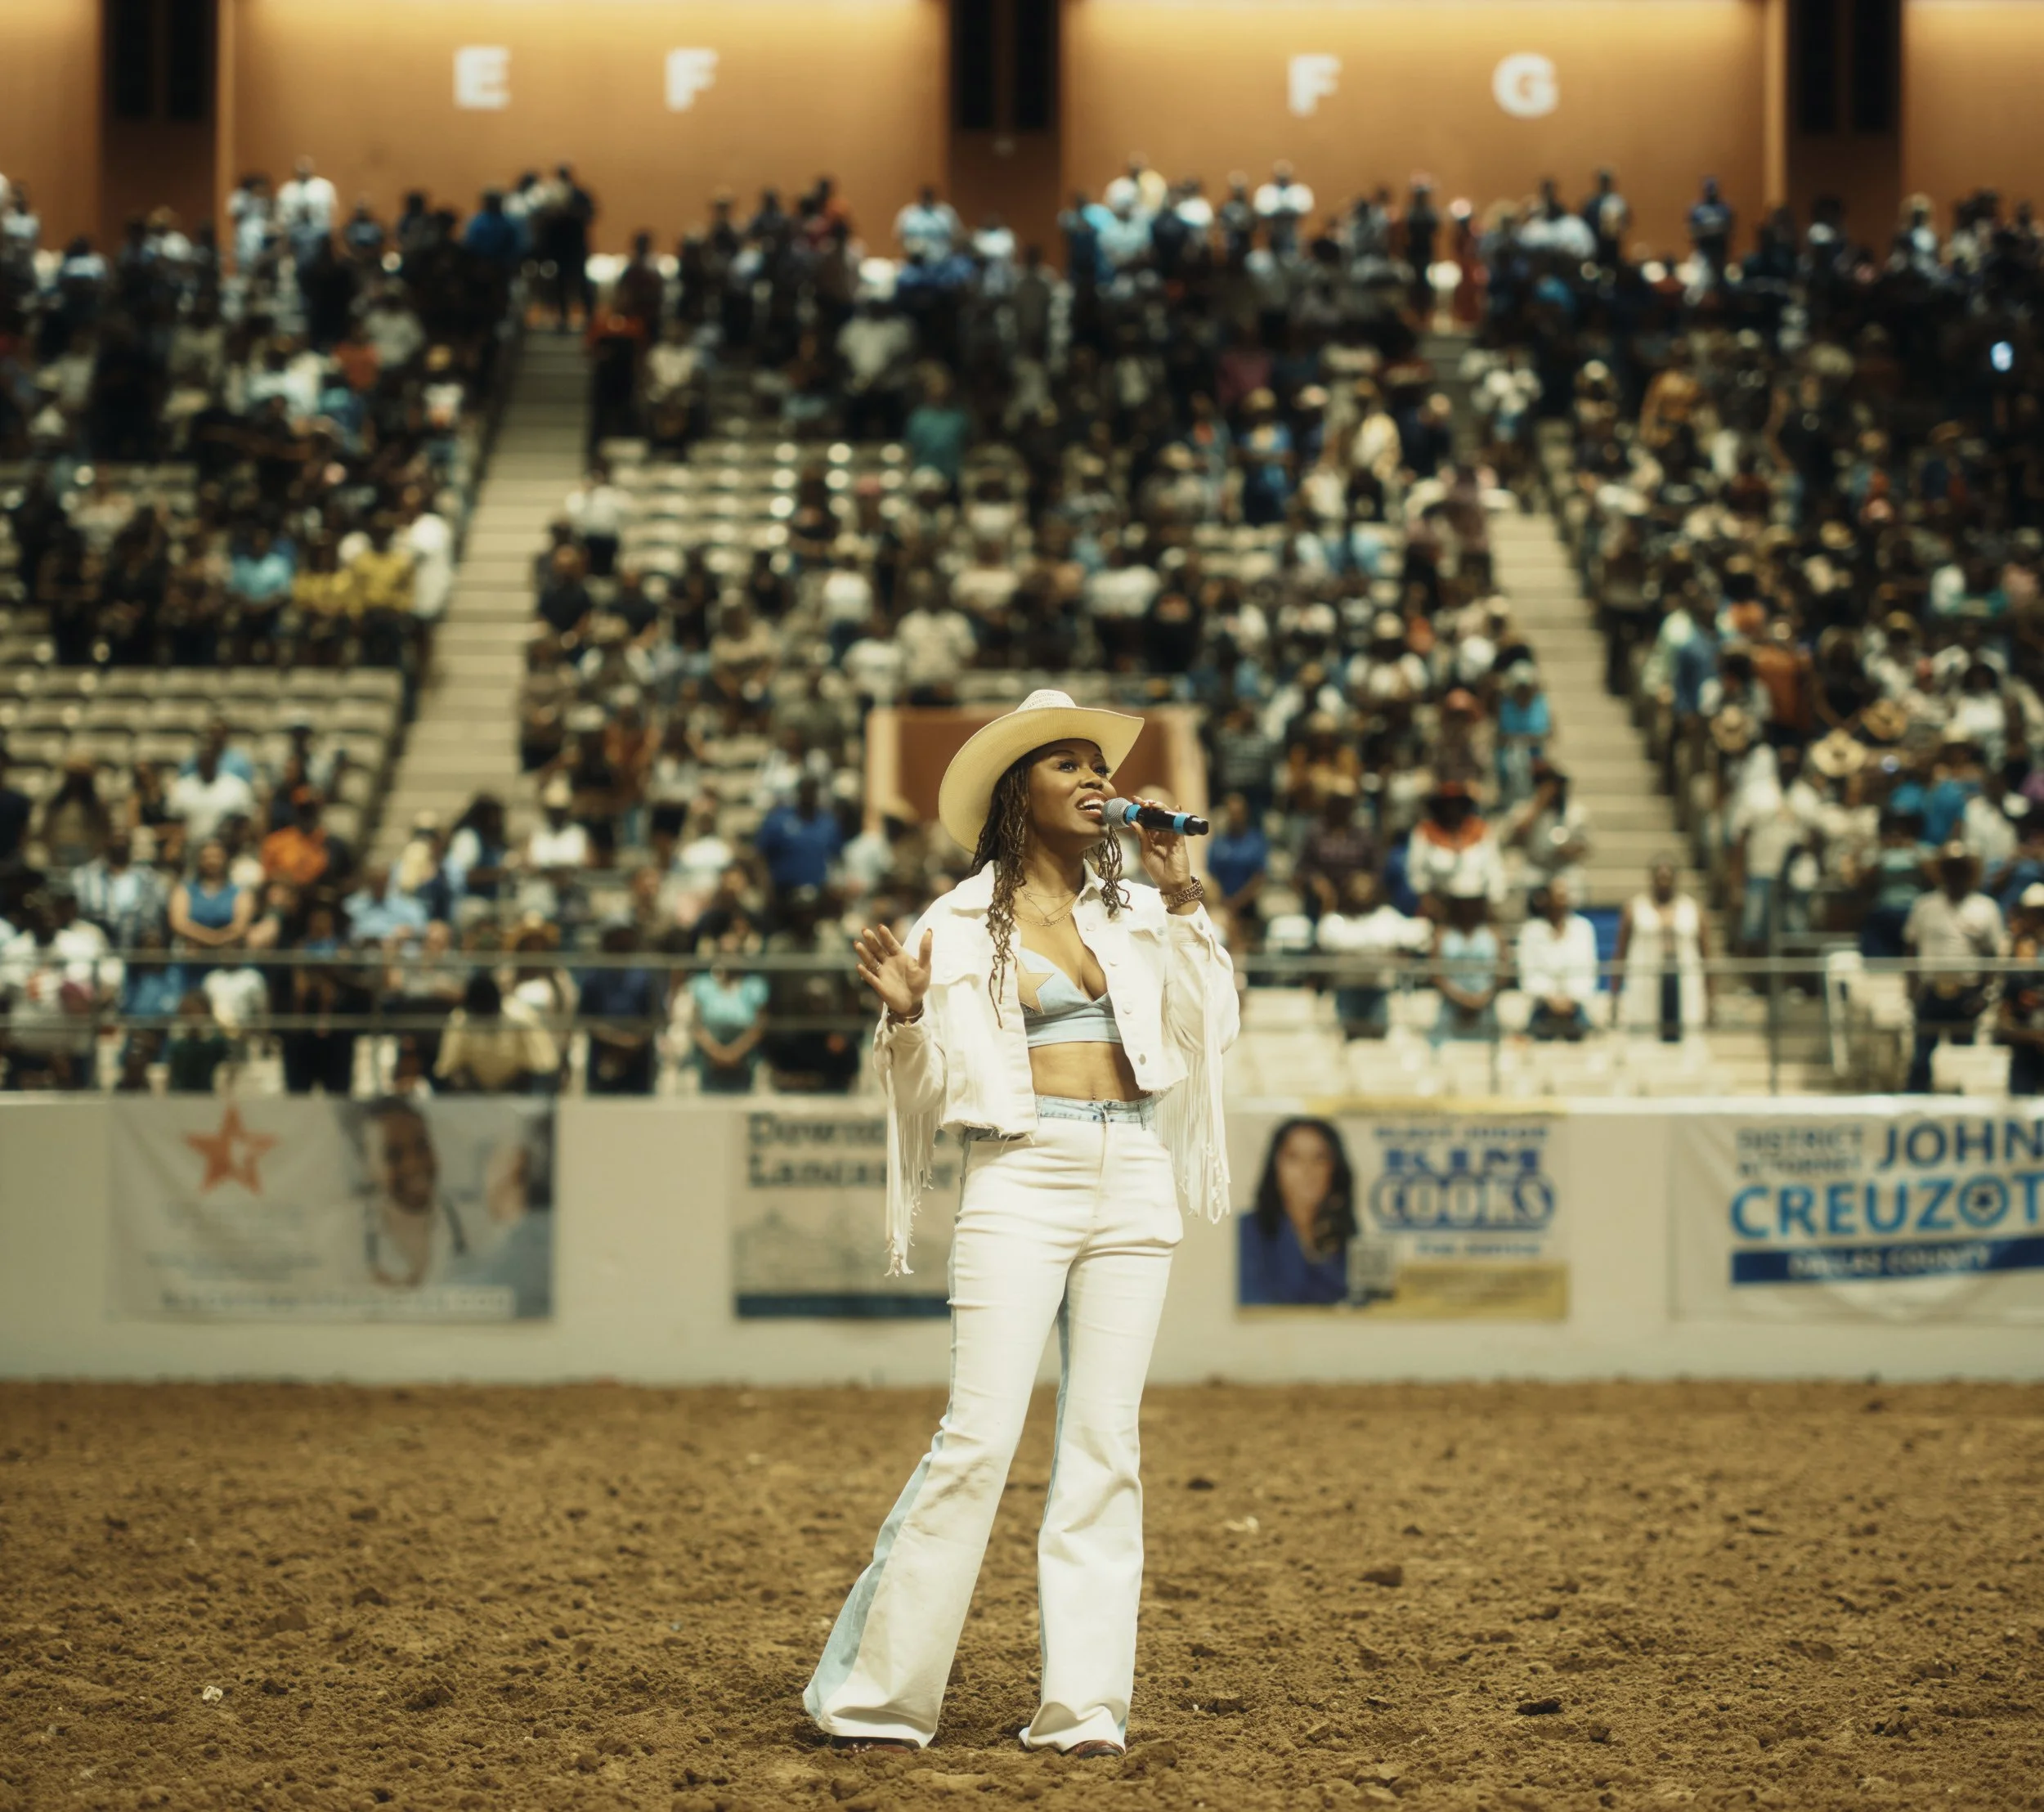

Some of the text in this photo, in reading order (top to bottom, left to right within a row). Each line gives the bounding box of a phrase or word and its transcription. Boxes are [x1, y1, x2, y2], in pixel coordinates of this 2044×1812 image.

[455, 46, 510, 109] E
[665, 47, 718, 111] F
[1288, 54, 1340, 117] F
[1492, 52, 1558, 118] G
[1383, 1148, 1539, 1176] KIM
[1876, 1119, 2044, 1171] JOHN
[1370, 1173, 1557, 1231] COOKS
[1730, 1173, 2044, 1239] CREUZOT
